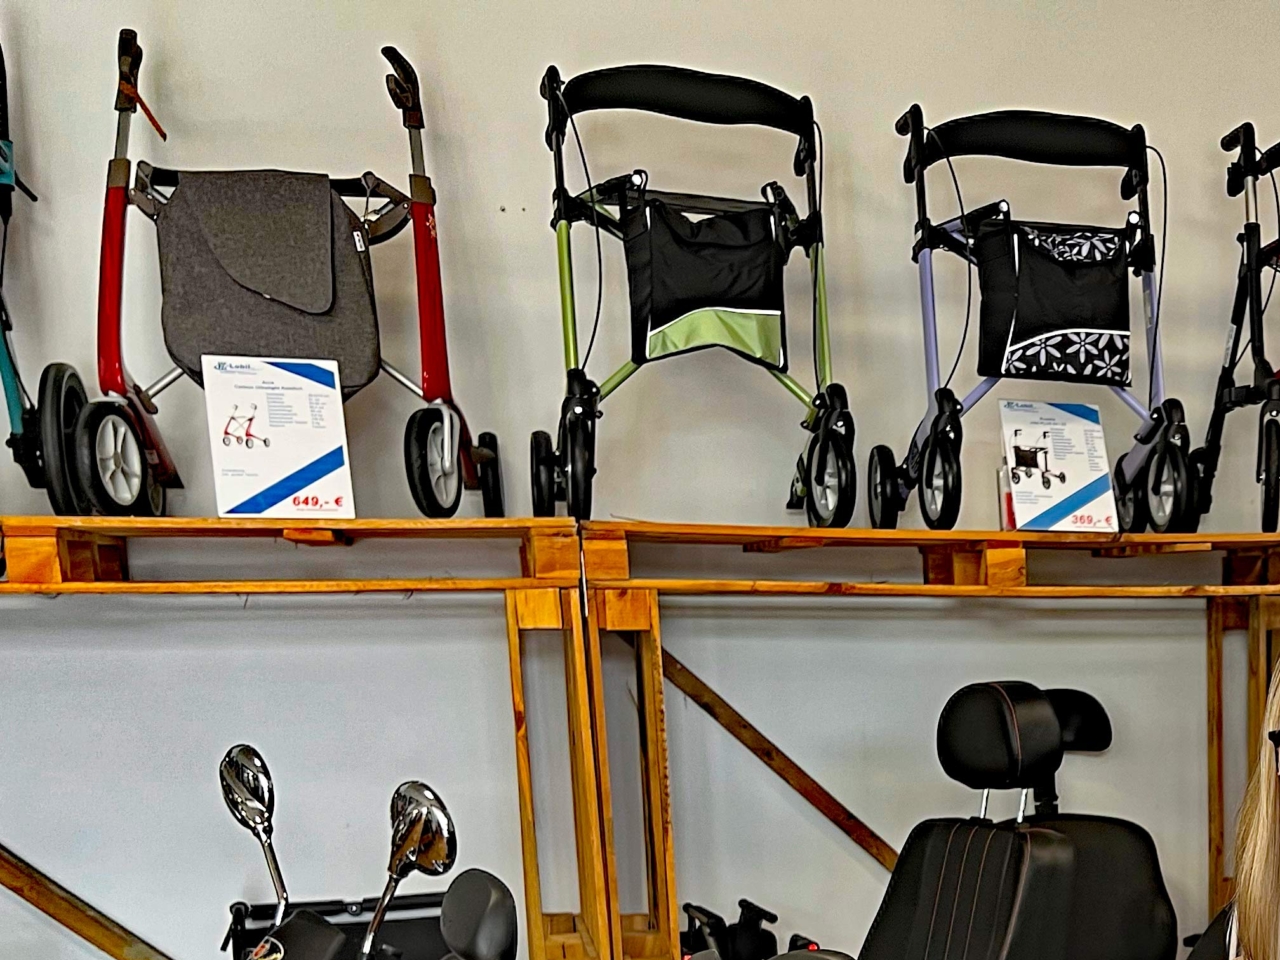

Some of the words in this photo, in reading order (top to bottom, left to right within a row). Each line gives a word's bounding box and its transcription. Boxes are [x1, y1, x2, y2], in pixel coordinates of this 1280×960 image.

[293, 496, 329, 509] 649,-
[334, 496, 343, 507] €
[1072, 514, 1102, 527] 369,-
[1105, 516, 1113, 525] €
